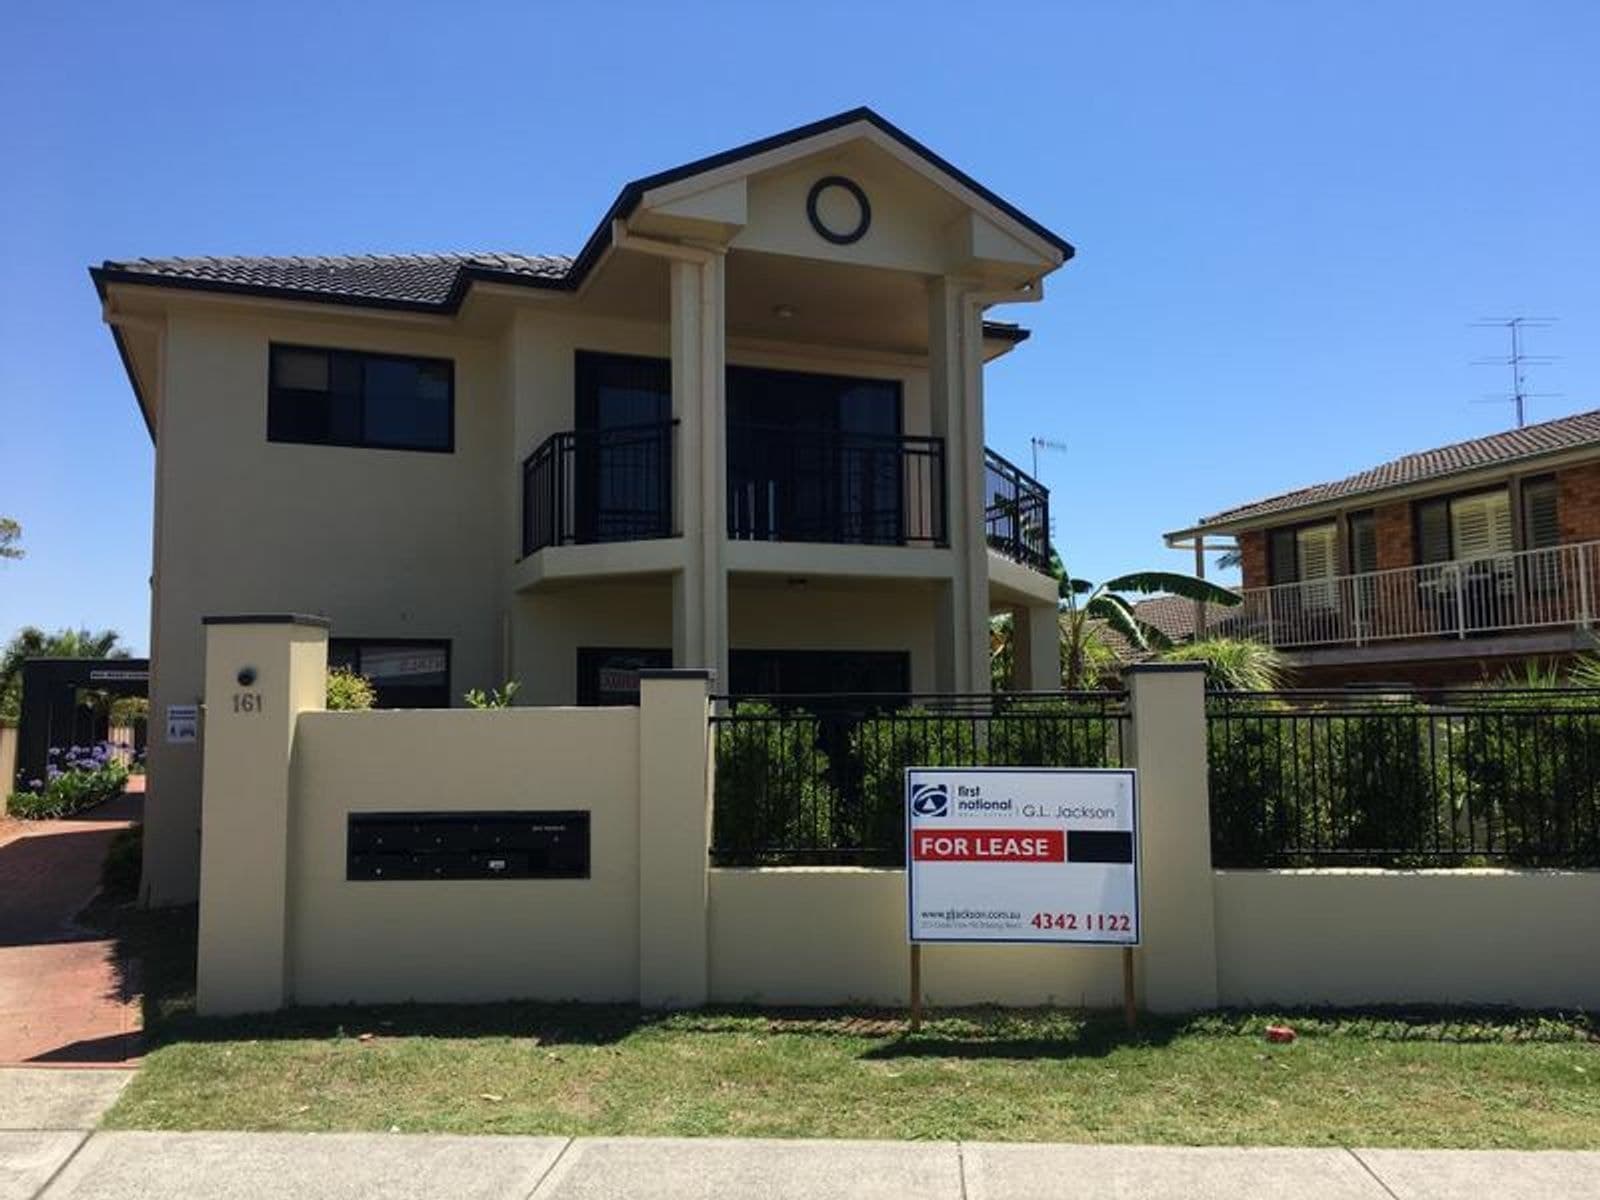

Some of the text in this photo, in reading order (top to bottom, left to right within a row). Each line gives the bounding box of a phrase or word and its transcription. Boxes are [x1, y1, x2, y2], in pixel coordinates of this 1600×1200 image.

[233, 693, 262, 712] 161
[958, 786, 980, 797] first
[958, 798, 1012, 810] national
[1056, 805, 1115, 819] Jackson
[921, 837, 1050, 856] FOR LEASE
[1031, 913, 1078, 930] 4342
[1087, 914, 1131, 931] 1122
